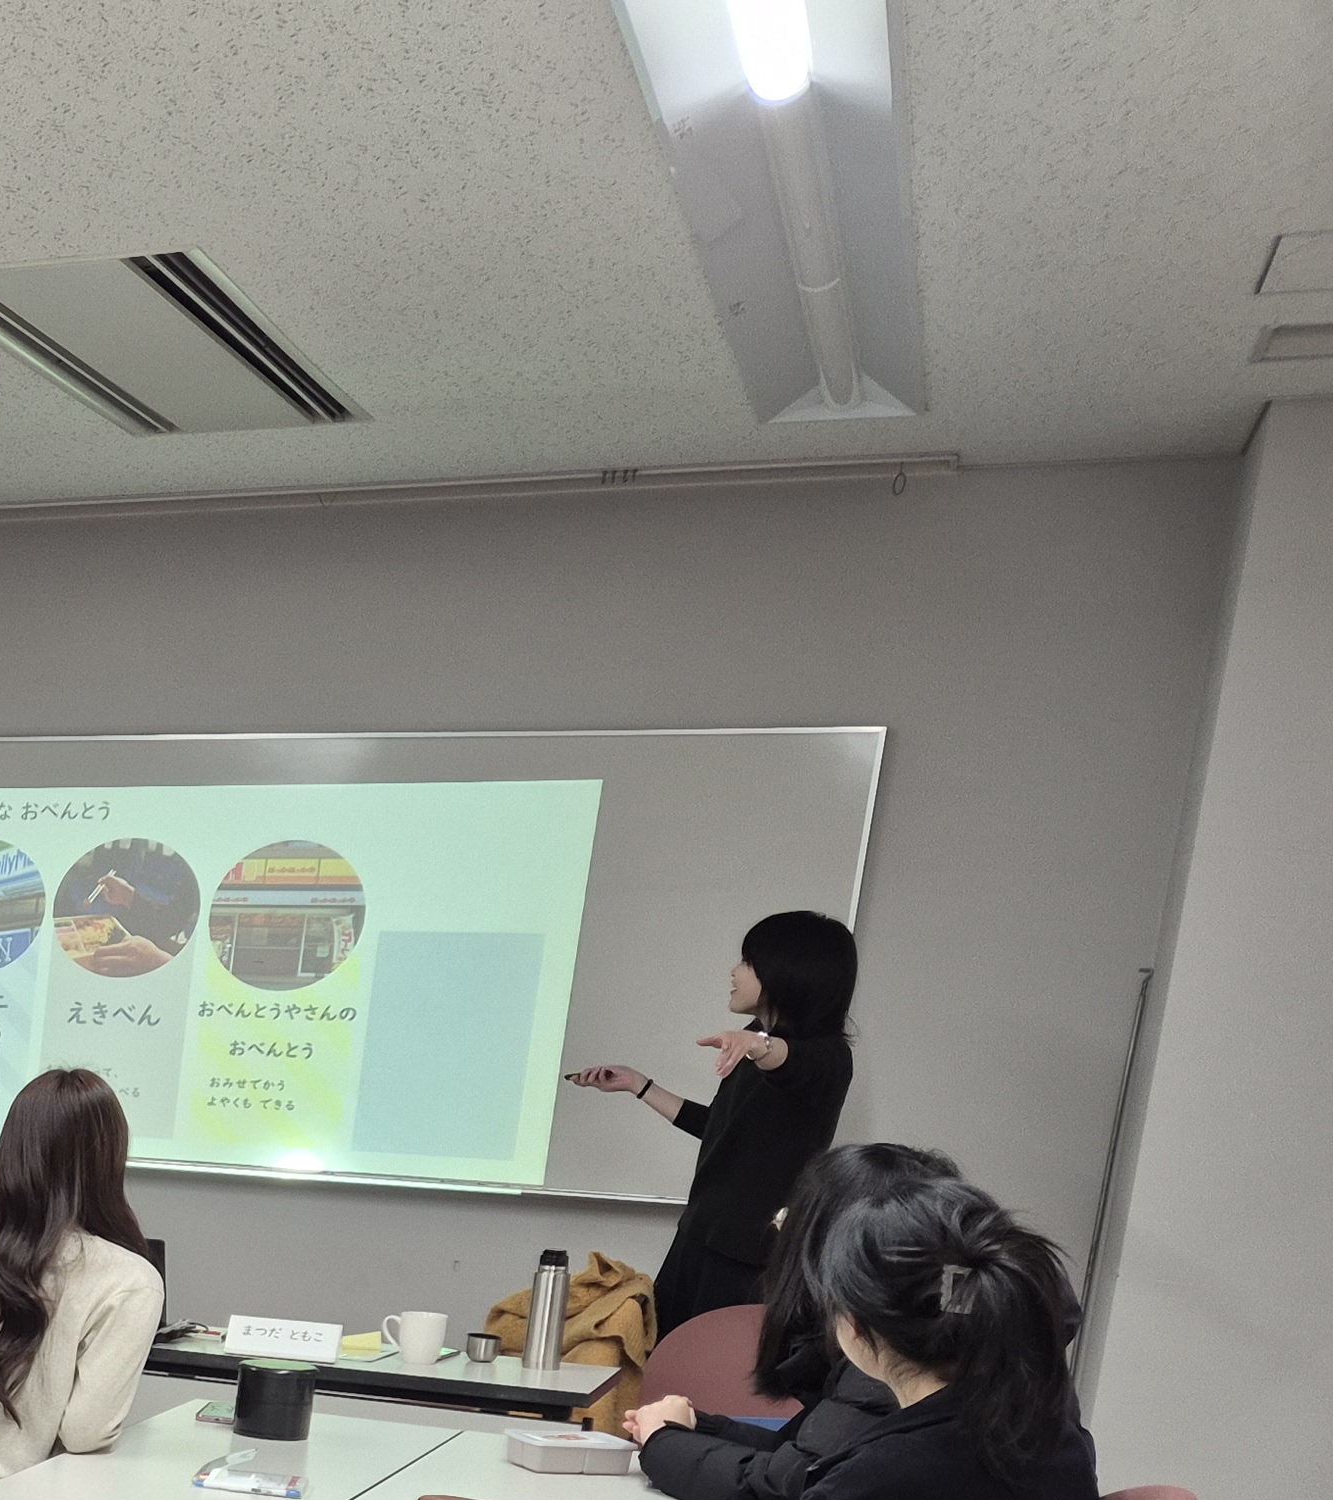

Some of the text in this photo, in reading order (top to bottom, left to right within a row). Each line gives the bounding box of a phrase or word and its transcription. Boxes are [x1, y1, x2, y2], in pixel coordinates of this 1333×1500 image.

[20, 801, 111, 821] おべんとう
[67, 1001, 161, 1027] えきべん
[197, 1000, 358, 1022] おべんとうやさんの
[228, 1039, 315, 1060] おべんとう
[206, 1096, 252, 1110] よやくも
[242, 1324, 324, 1343] まつだ ともこ
